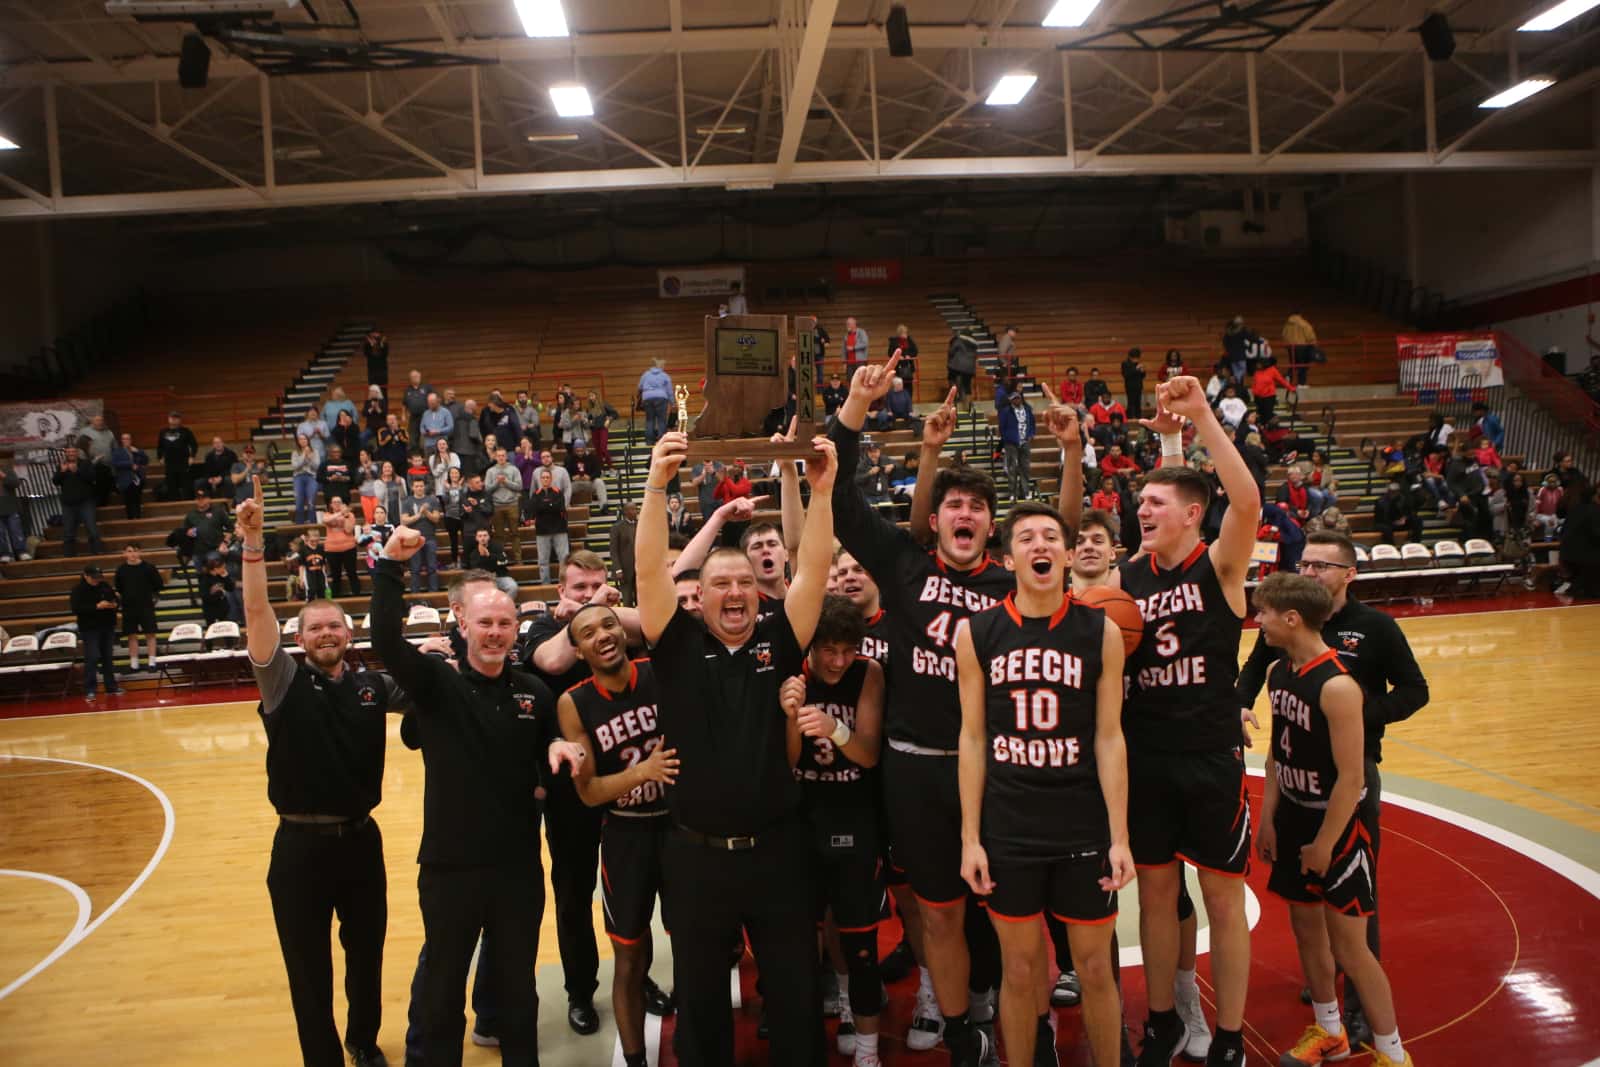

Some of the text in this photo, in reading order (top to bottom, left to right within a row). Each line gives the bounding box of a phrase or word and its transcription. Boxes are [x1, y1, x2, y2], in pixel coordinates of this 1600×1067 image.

[1154, 619, 1181, 658] 5
[989, 647, 1083, 690] BEECH
[594, 703, 659, 753] BEEC
[1008, 688, 1060, 731] 10
[813, 736, 835, 767] 3
[992, 734, 1081, 768] GROVE
[1280, 723, 1293, 760] 4
